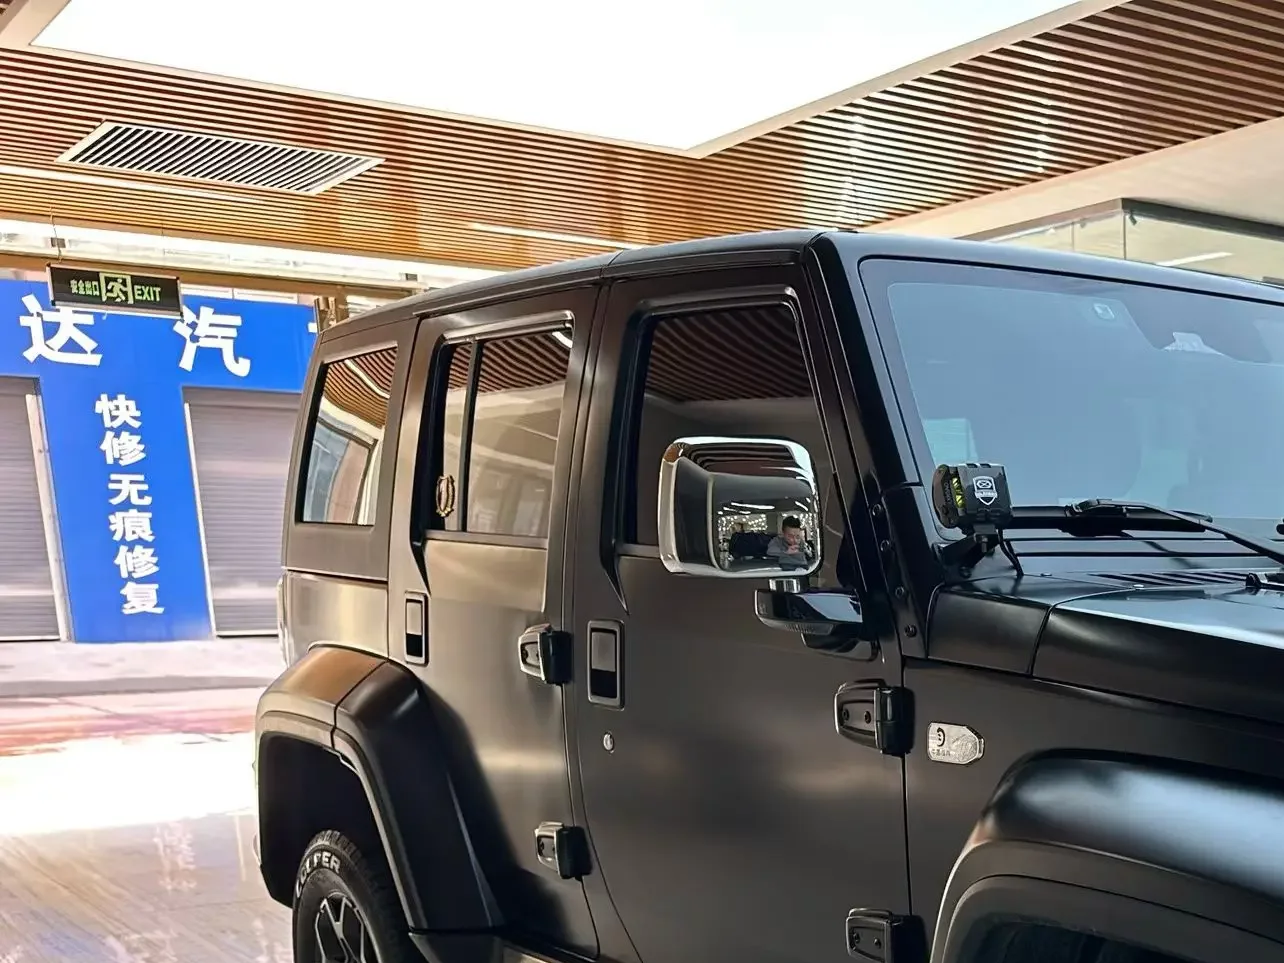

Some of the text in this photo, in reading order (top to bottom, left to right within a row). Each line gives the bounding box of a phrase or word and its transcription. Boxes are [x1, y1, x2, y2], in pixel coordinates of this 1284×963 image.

[133, 285, 162, 302] EXIT
[95, 393, 165, 615] 快修无痕修复
